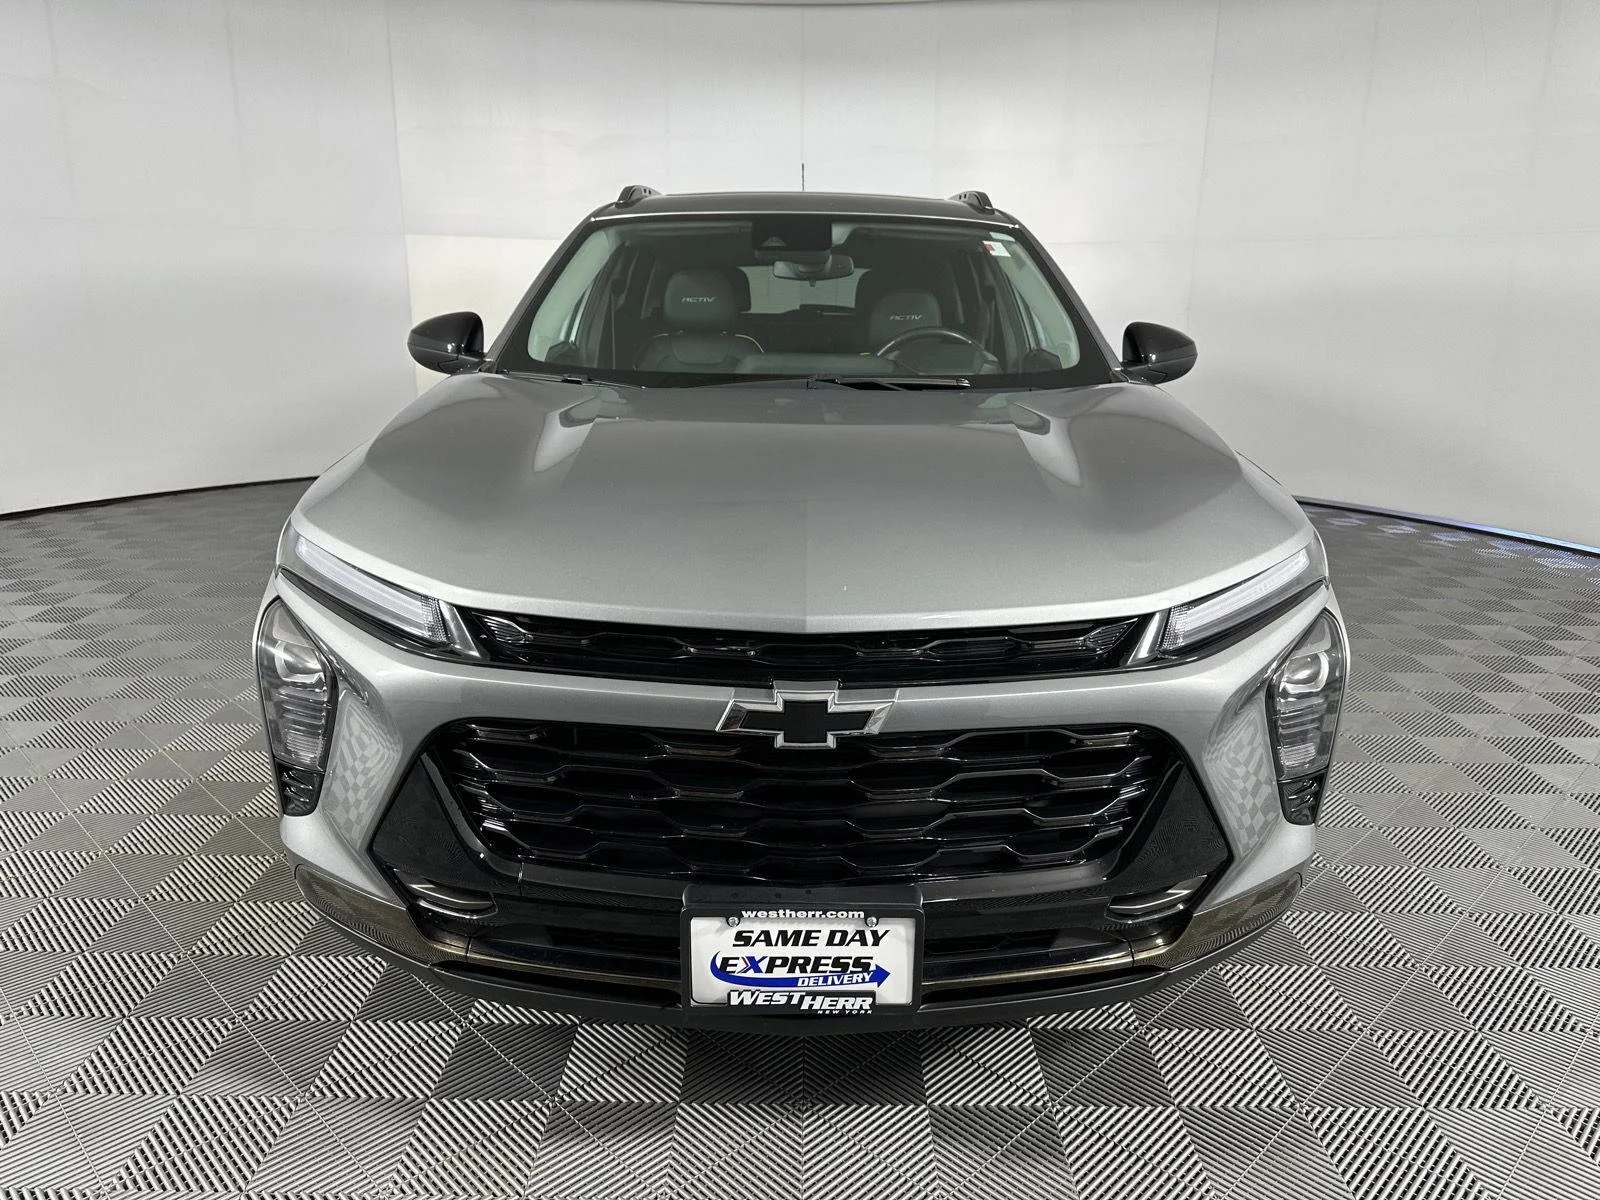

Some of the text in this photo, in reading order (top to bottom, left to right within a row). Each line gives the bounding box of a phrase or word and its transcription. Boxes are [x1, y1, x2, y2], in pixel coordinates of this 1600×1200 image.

[741, 909, 865, 919] westherr.com
[732, 929, 891, 947] SAME DAY
[719, 956, 874, 974] EXPRESS
[797, 972, 874, 988] DELIVERY
[730, 991, 873, 1010] WEST HERR
